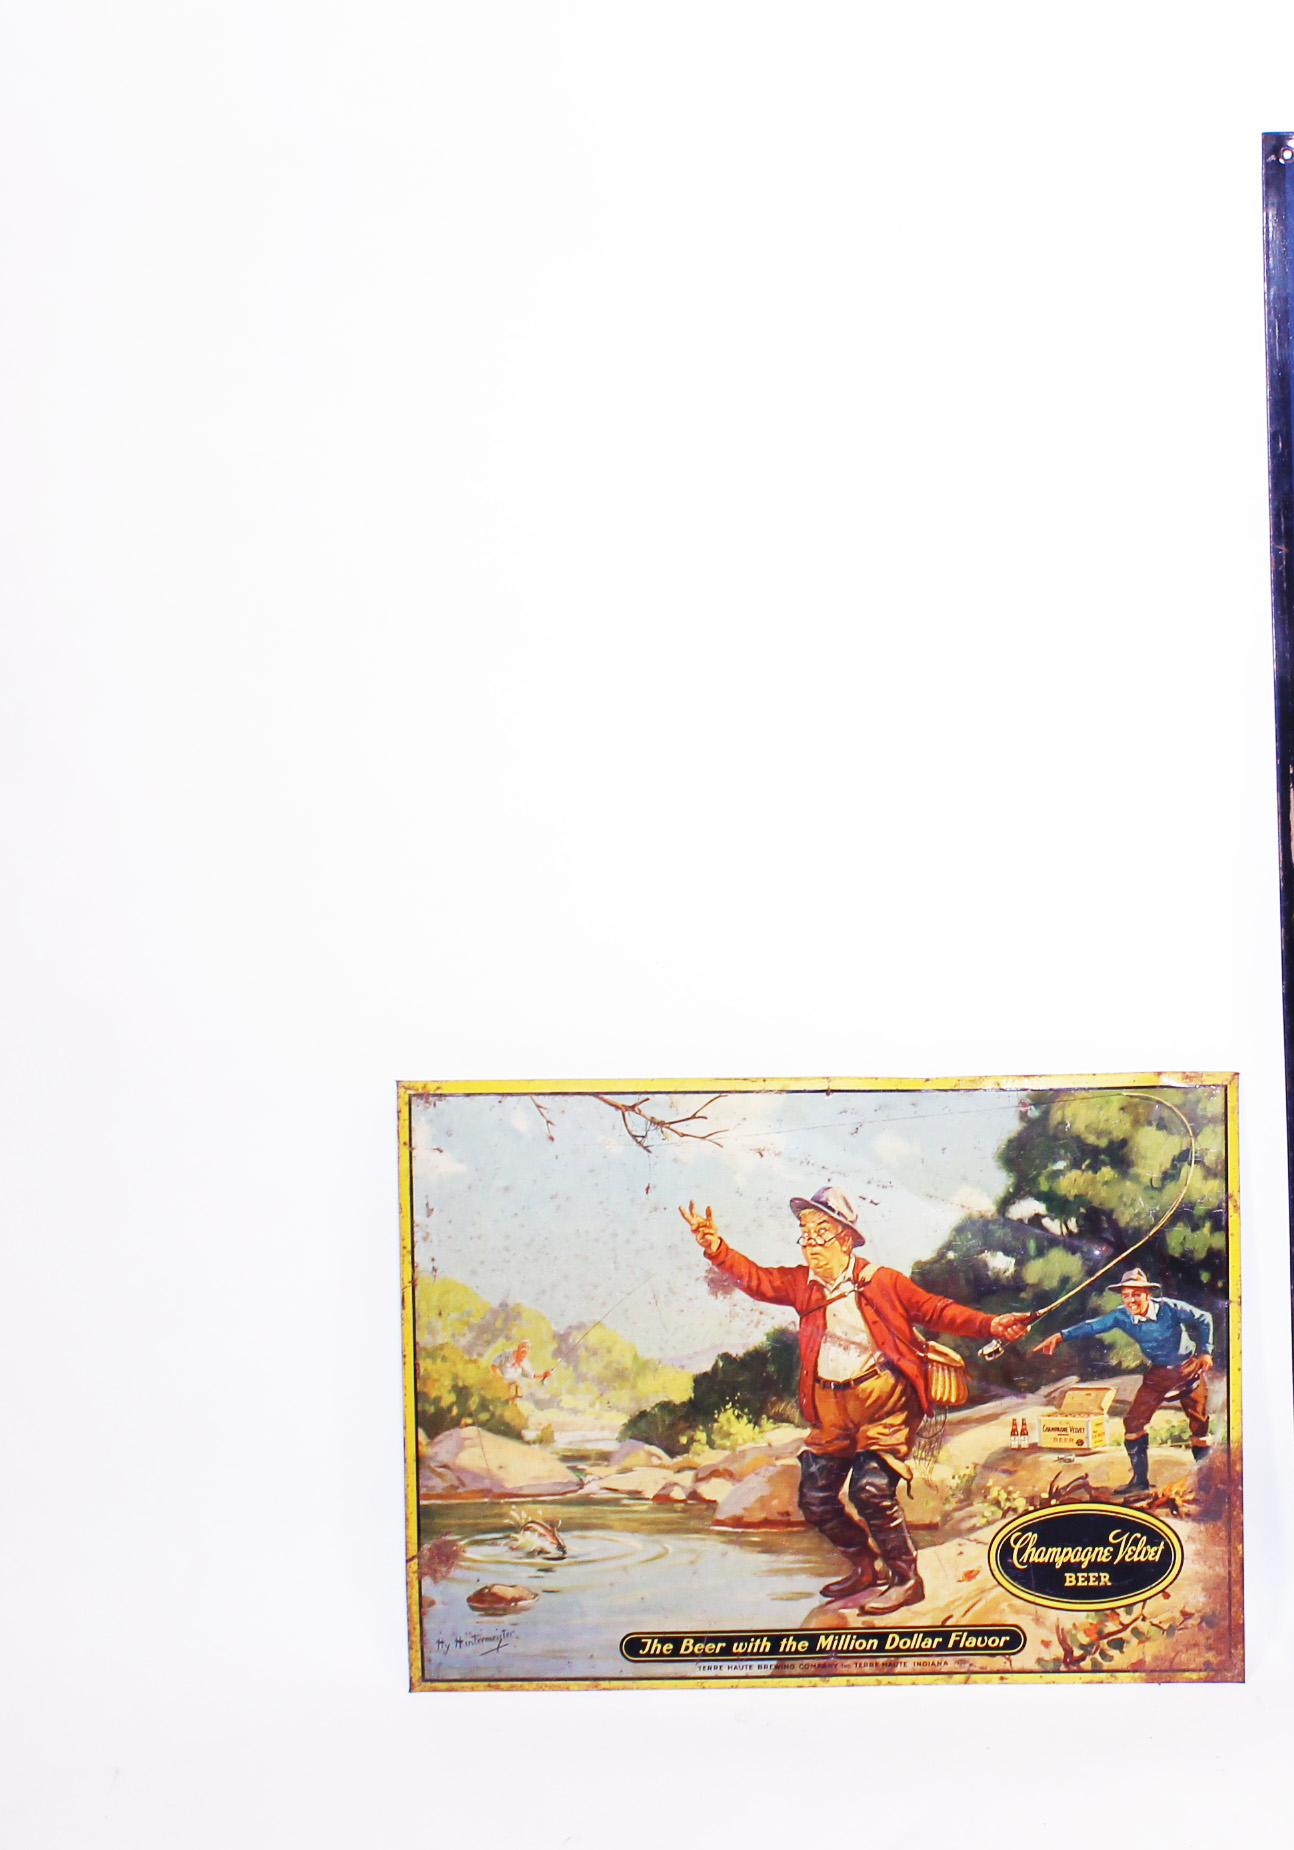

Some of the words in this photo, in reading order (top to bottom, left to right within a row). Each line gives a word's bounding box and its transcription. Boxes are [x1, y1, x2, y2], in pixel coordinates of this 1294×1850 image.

[1009, 1531, 1114, 1569] Champagne
[1108, 1529, 1166, 1566] Velvet
[1064, 1572, 1112, 1587] BEER
[638, 1638, 673, 1656] The
[679, 1638, 726, 1655] Beer
[732, 1636, 772, 1654] with
[779, 1636, 810, 1654] the
[816, 1634, 879, 1652] Million
[884, 1633, 943, 1651] Dollar
[947, 1632, 1011, 1649] Flavor
[697, 1664, 724, 1672] TERRE
[727, 1663, 754, 1672] HAUTE
[757, 1662, 796, 1671] BREWING
[798, 1662, 839, 1671] COMPANY
[853, 1661, 879, 1669] TERRE
[913, 1659, 949, 1668] INDIANA
